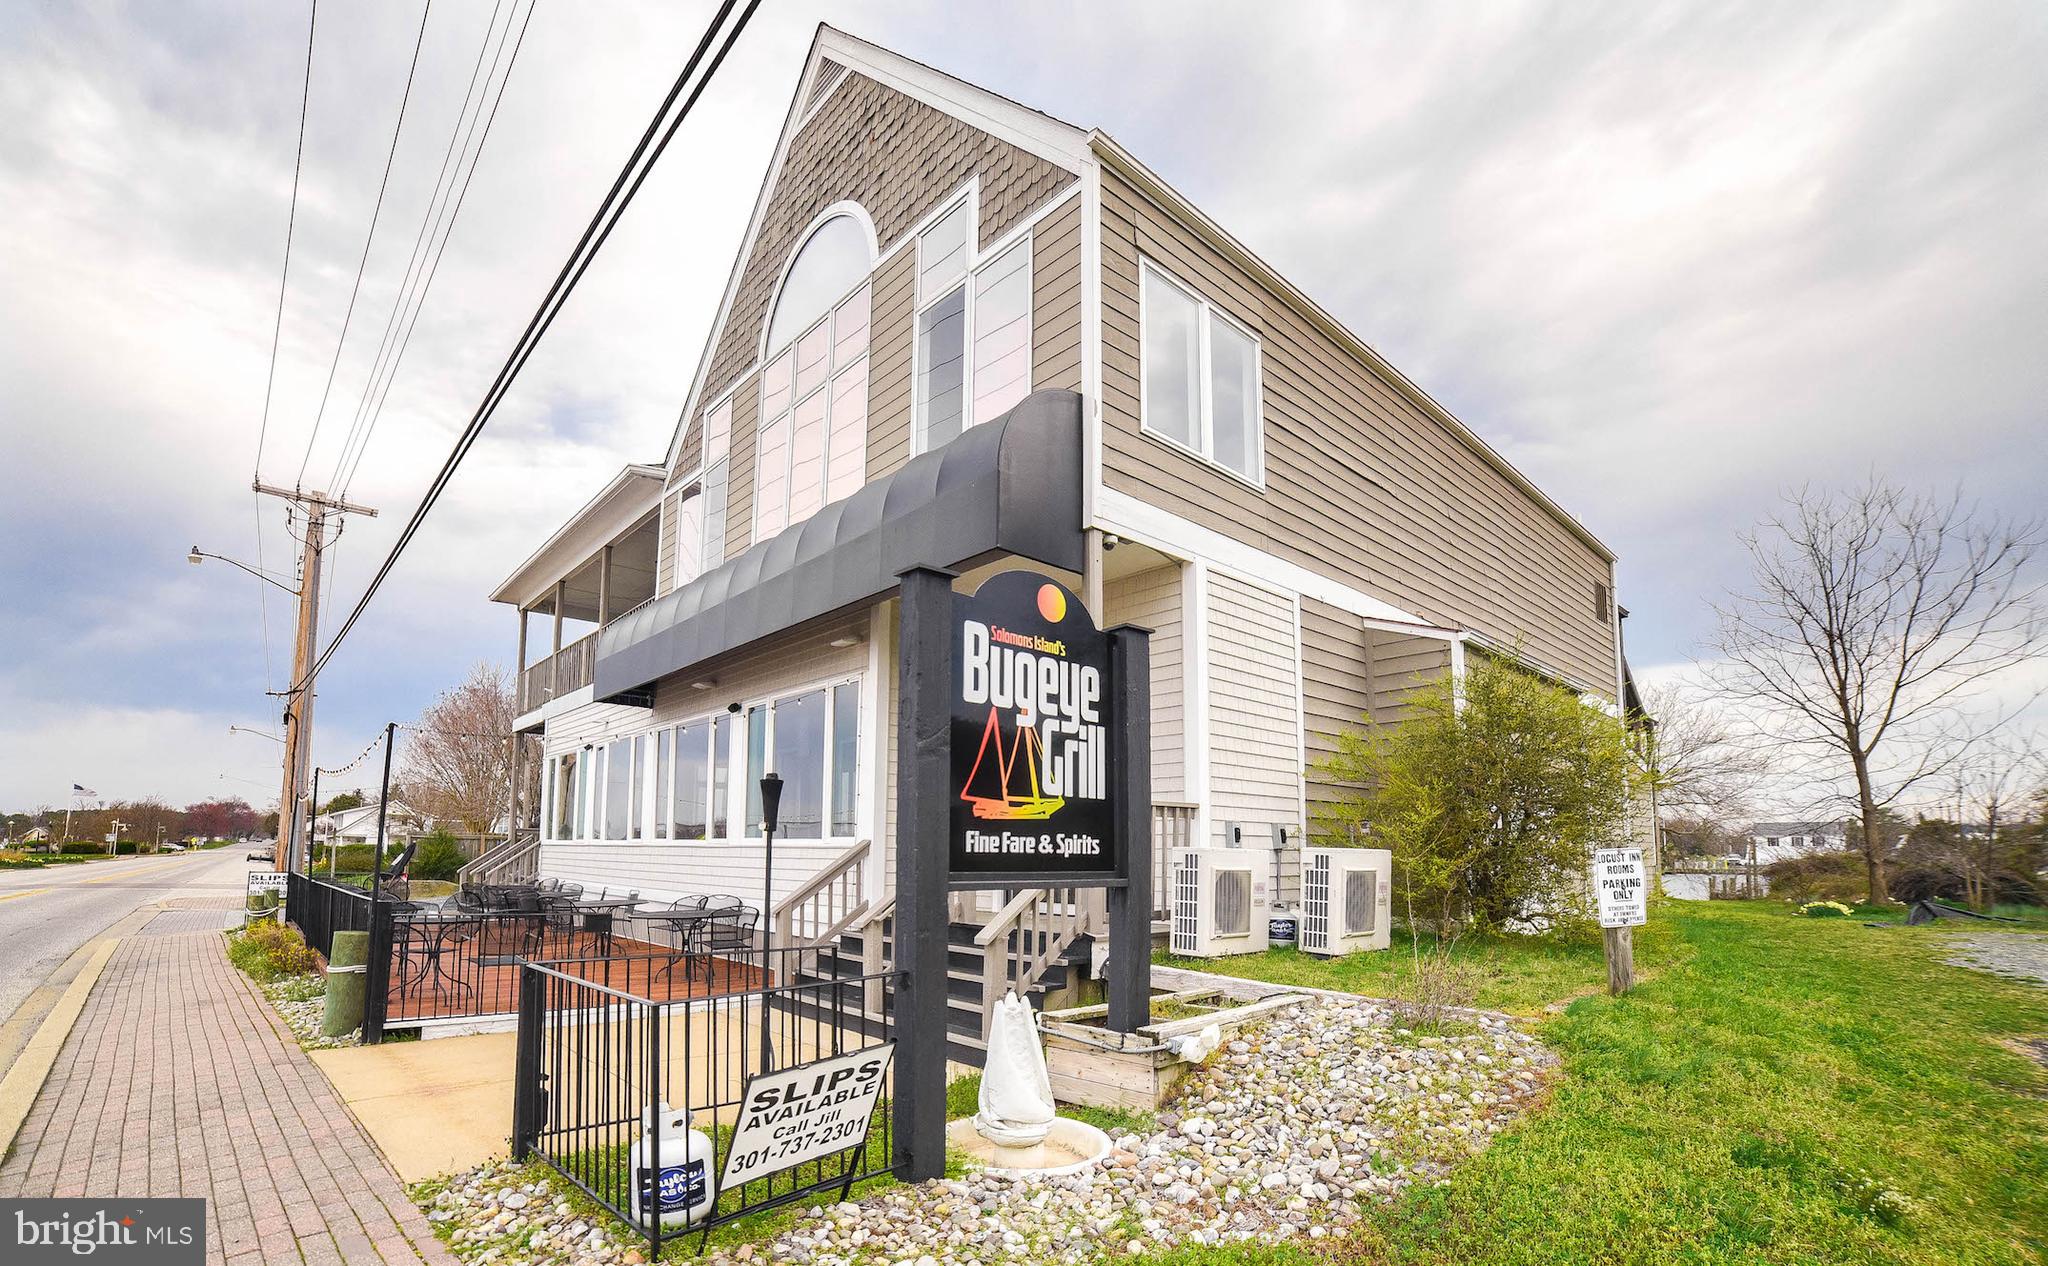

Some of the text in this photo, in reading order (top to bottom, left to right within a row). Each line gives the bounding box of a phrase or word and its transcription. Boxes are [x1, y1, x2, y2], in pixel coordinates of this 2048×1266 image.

[991, 625, 1066, 656] Solomons Island's
[963, 619, 1100, 734] Bugeye
[1042, 718, 1105, 800] Grill
[965, 830, 1100, 858] Fine Fare & Spirits
[1598, 852, 1641, 863] LOCUST INN
[1602, 878, 1641, 889] PARKING
[1607, 864, 1634, 874] ROOMS
[1613, 890, 1633, 900] ONLY
[750, 1060, 881, 1113] SLIPS
[744, 1081, 876, 1132] AVAILABLE
[773, 1109, 841, 1139] Call Jill
[731, 1115, 865, 1174] 301-737-2301
